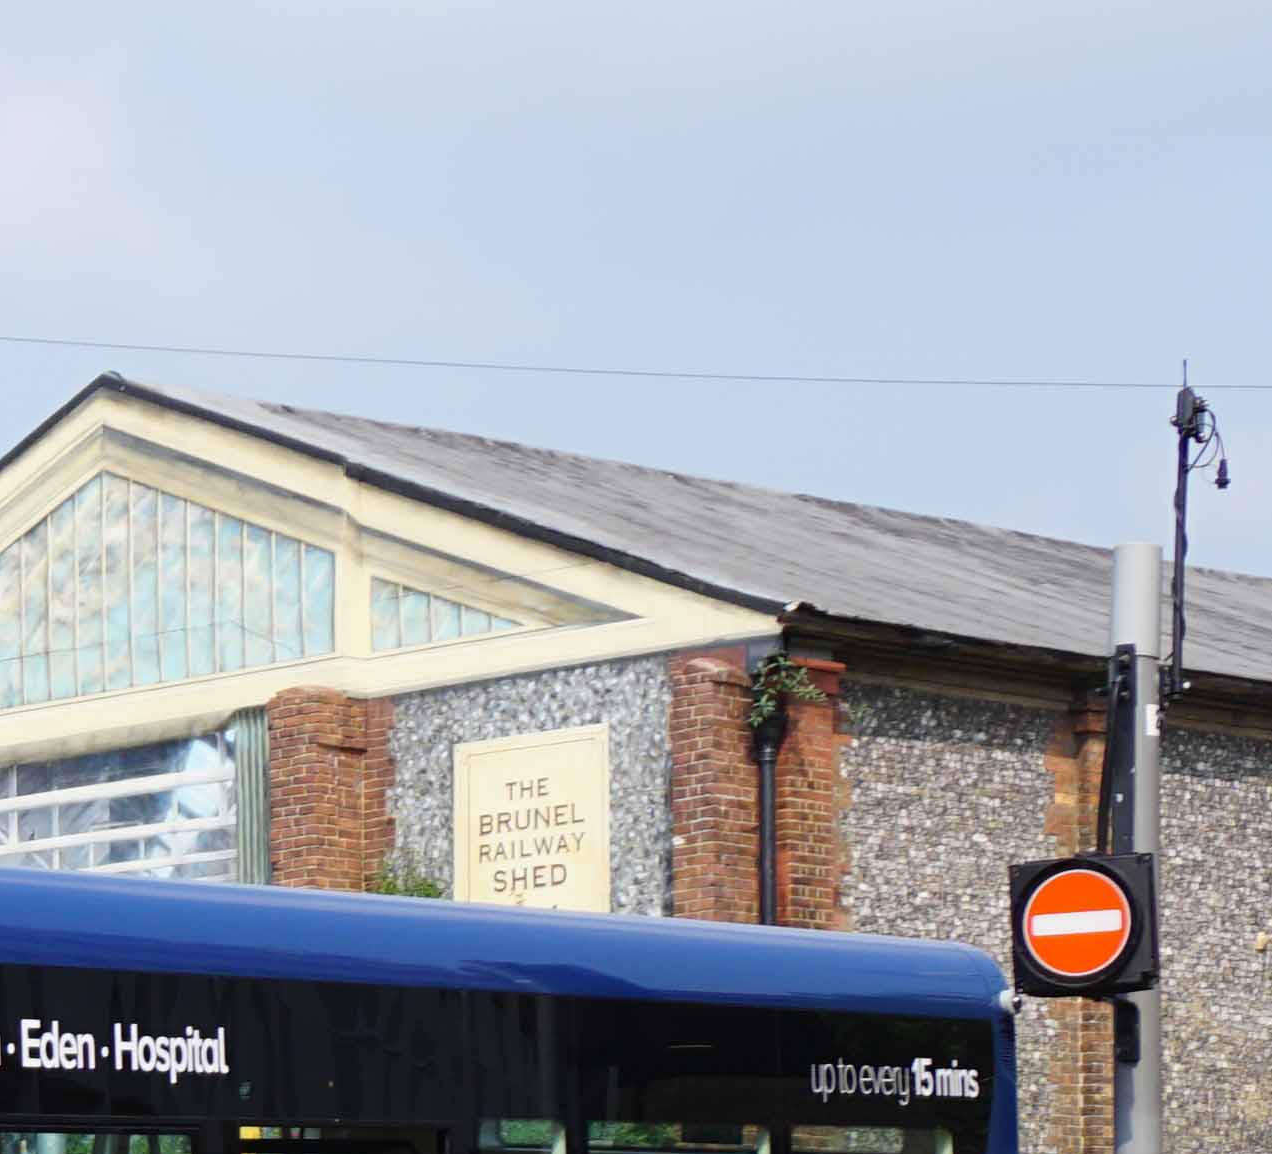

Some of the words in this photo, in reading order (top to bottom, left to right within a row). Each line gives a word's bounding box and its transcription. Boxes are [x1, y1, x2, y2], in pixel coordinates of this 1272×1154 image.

[506, 777, 549, 800] THE
[479, 803, 585, 836] BRUNEL
[479, 832, 585, 864] RAILWAY
[494, 864, 567, 892] SHED
[21, 1018, 96, 1070] Eden
[114, 1023, 229, 1084] Hospital
[811, 1063, 836, 1103] up
[837, 1057, 856, 1094] to
[859, 1065, 910, 1106] every
[912, 1058, 933, 1096] 15
[935, 1059, 980, 1098] mins
